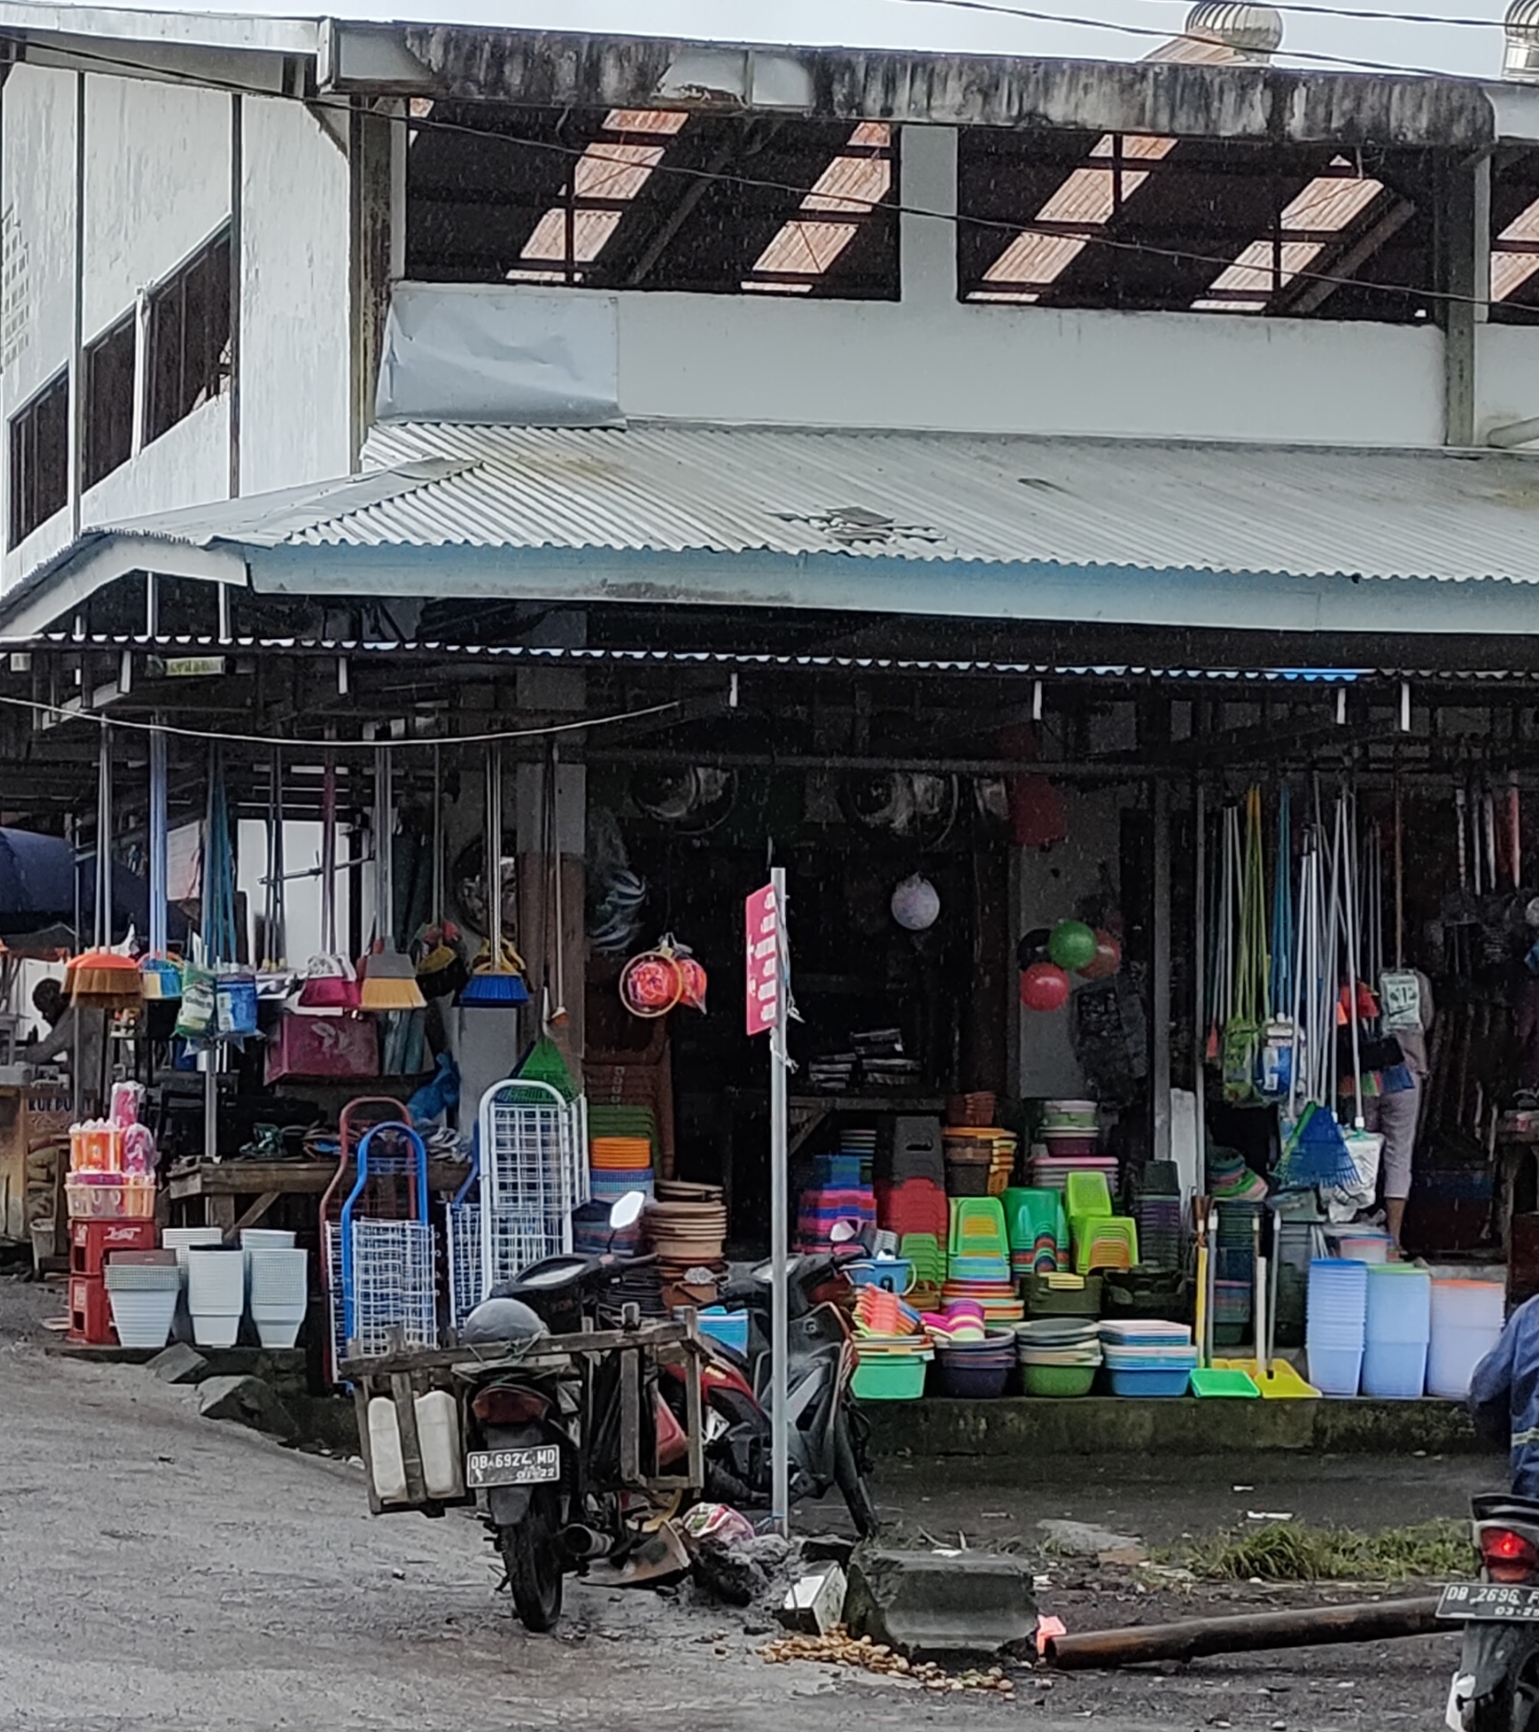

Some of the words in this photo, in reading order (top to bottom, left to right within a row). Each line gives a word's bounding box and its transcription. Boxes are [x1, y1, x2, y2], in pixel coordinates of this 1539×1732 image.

[471, 1454, 489, 1470] DB
[537, 1448, 556, 1465] MD
[1446, 1585, 1469, 1601] DB
[1476, 1587, 1521, 1604] 2696
